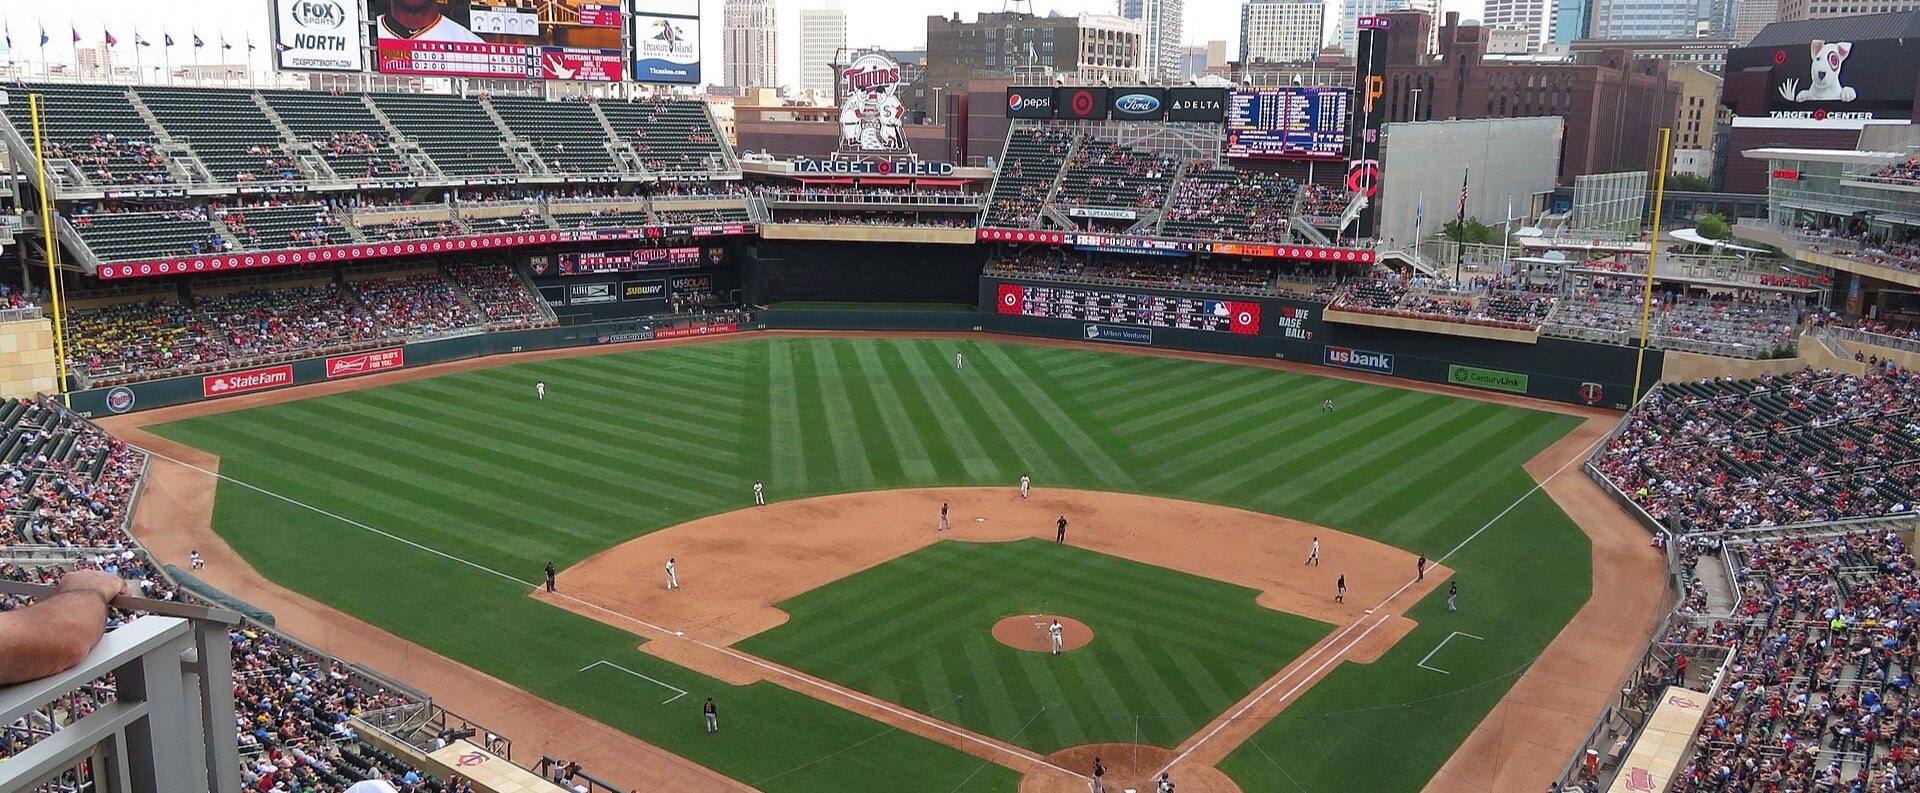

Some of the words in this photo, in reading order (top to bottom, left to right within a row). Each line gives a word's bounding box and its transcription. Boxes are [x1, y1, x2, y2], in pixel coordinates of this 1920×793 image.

[303, 2, 334, 19] FOX
[303, 17, 336, 26] SPORTS
[294, 33, 346, 51] NORTH
[642, 40, 668, 51] Treasure
[674, 42, 693, 54] Island
[649, 67, 688, 76] Ticasino.com
[843, 65, 900, 94] Twins
[1023, 98, 1050, 110] pepsi
[1122, 97, 1151, 111] Ford
[1184, 101, 1220, 109] DELTA
[883, 105, 892, 117] S
[1769, 110, 1813, 119] TARGET
[1826, 112, 1873, 120] CENTER
[794, 161, 875, 174] TARGET
[895, 161, 955, 176] FIELD
[1087, 210, 1130, 218] SUPERAMERICA
[626, 285, 661, 296] SUBWAY
[1295, 308, 1309, 319] WE
[1278, 317, 1302, 328] BASE
[1103, 329, 1122, 337] Urban
[1123, 331, 1150, 339] Ventures
[1285, 329, 1306, 339] BALL
[383, 351, 399, 360] BUD'S
[1329, 349, 1389, 368] usbank
[1470, 373, 1519, 387] CenturyLink
